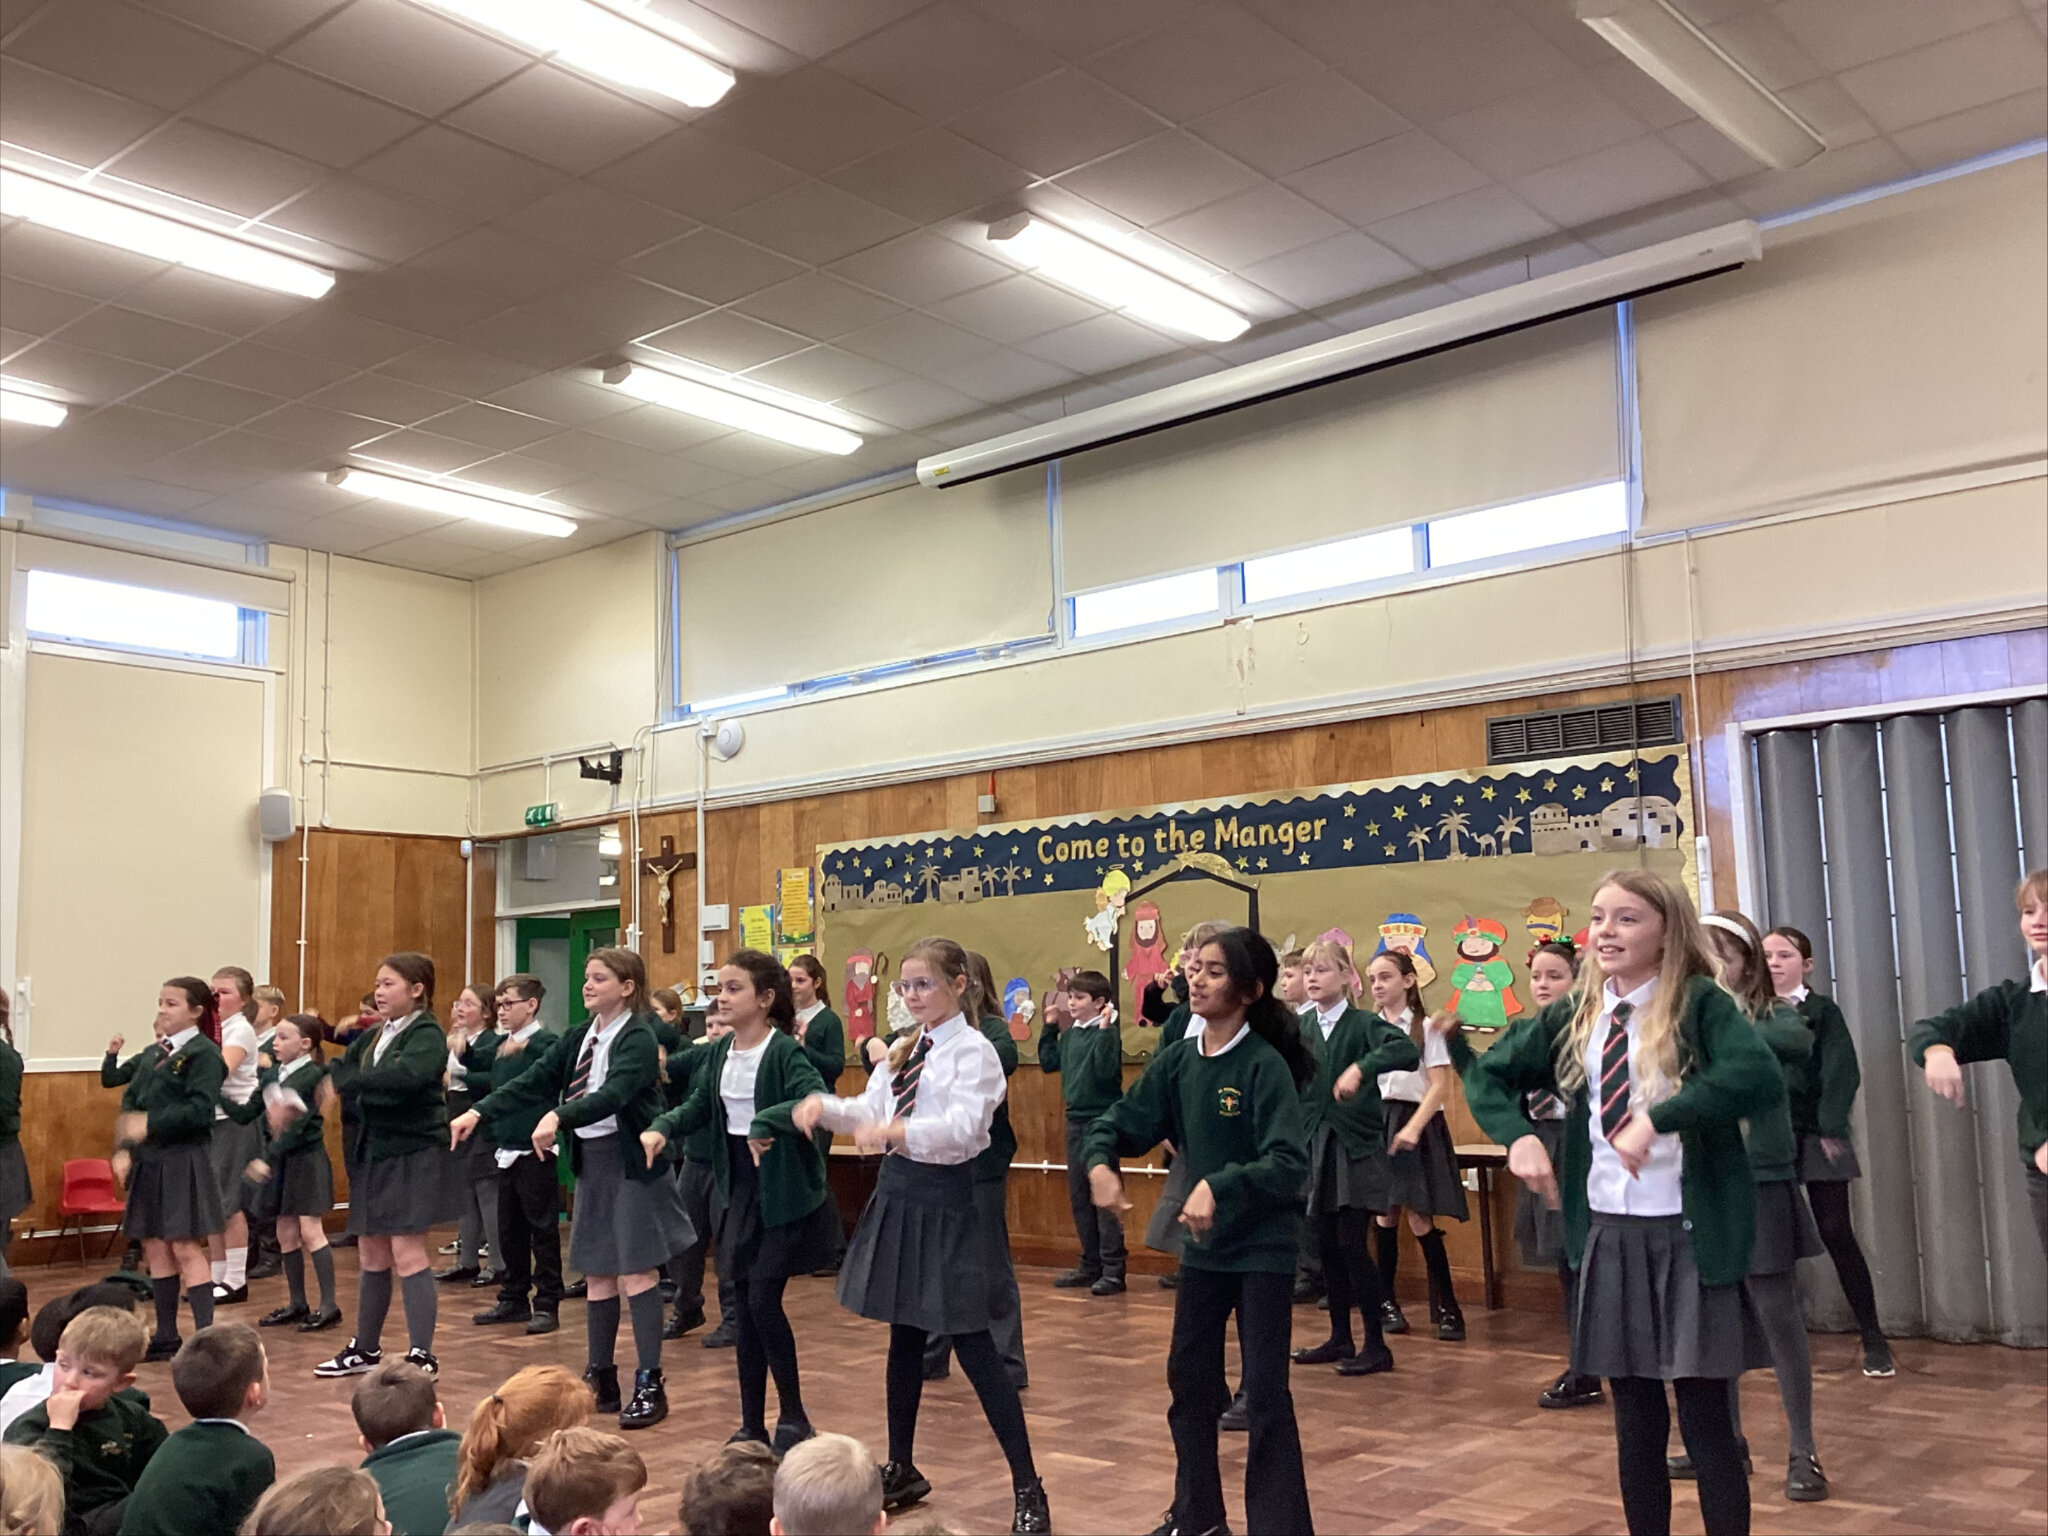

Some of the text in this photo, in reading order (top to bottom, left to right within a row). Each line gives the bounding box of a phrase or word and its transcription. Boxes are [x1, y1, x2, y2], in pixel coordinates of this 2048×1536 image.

[1037, 815, 1328, 866] Come to the Manger
